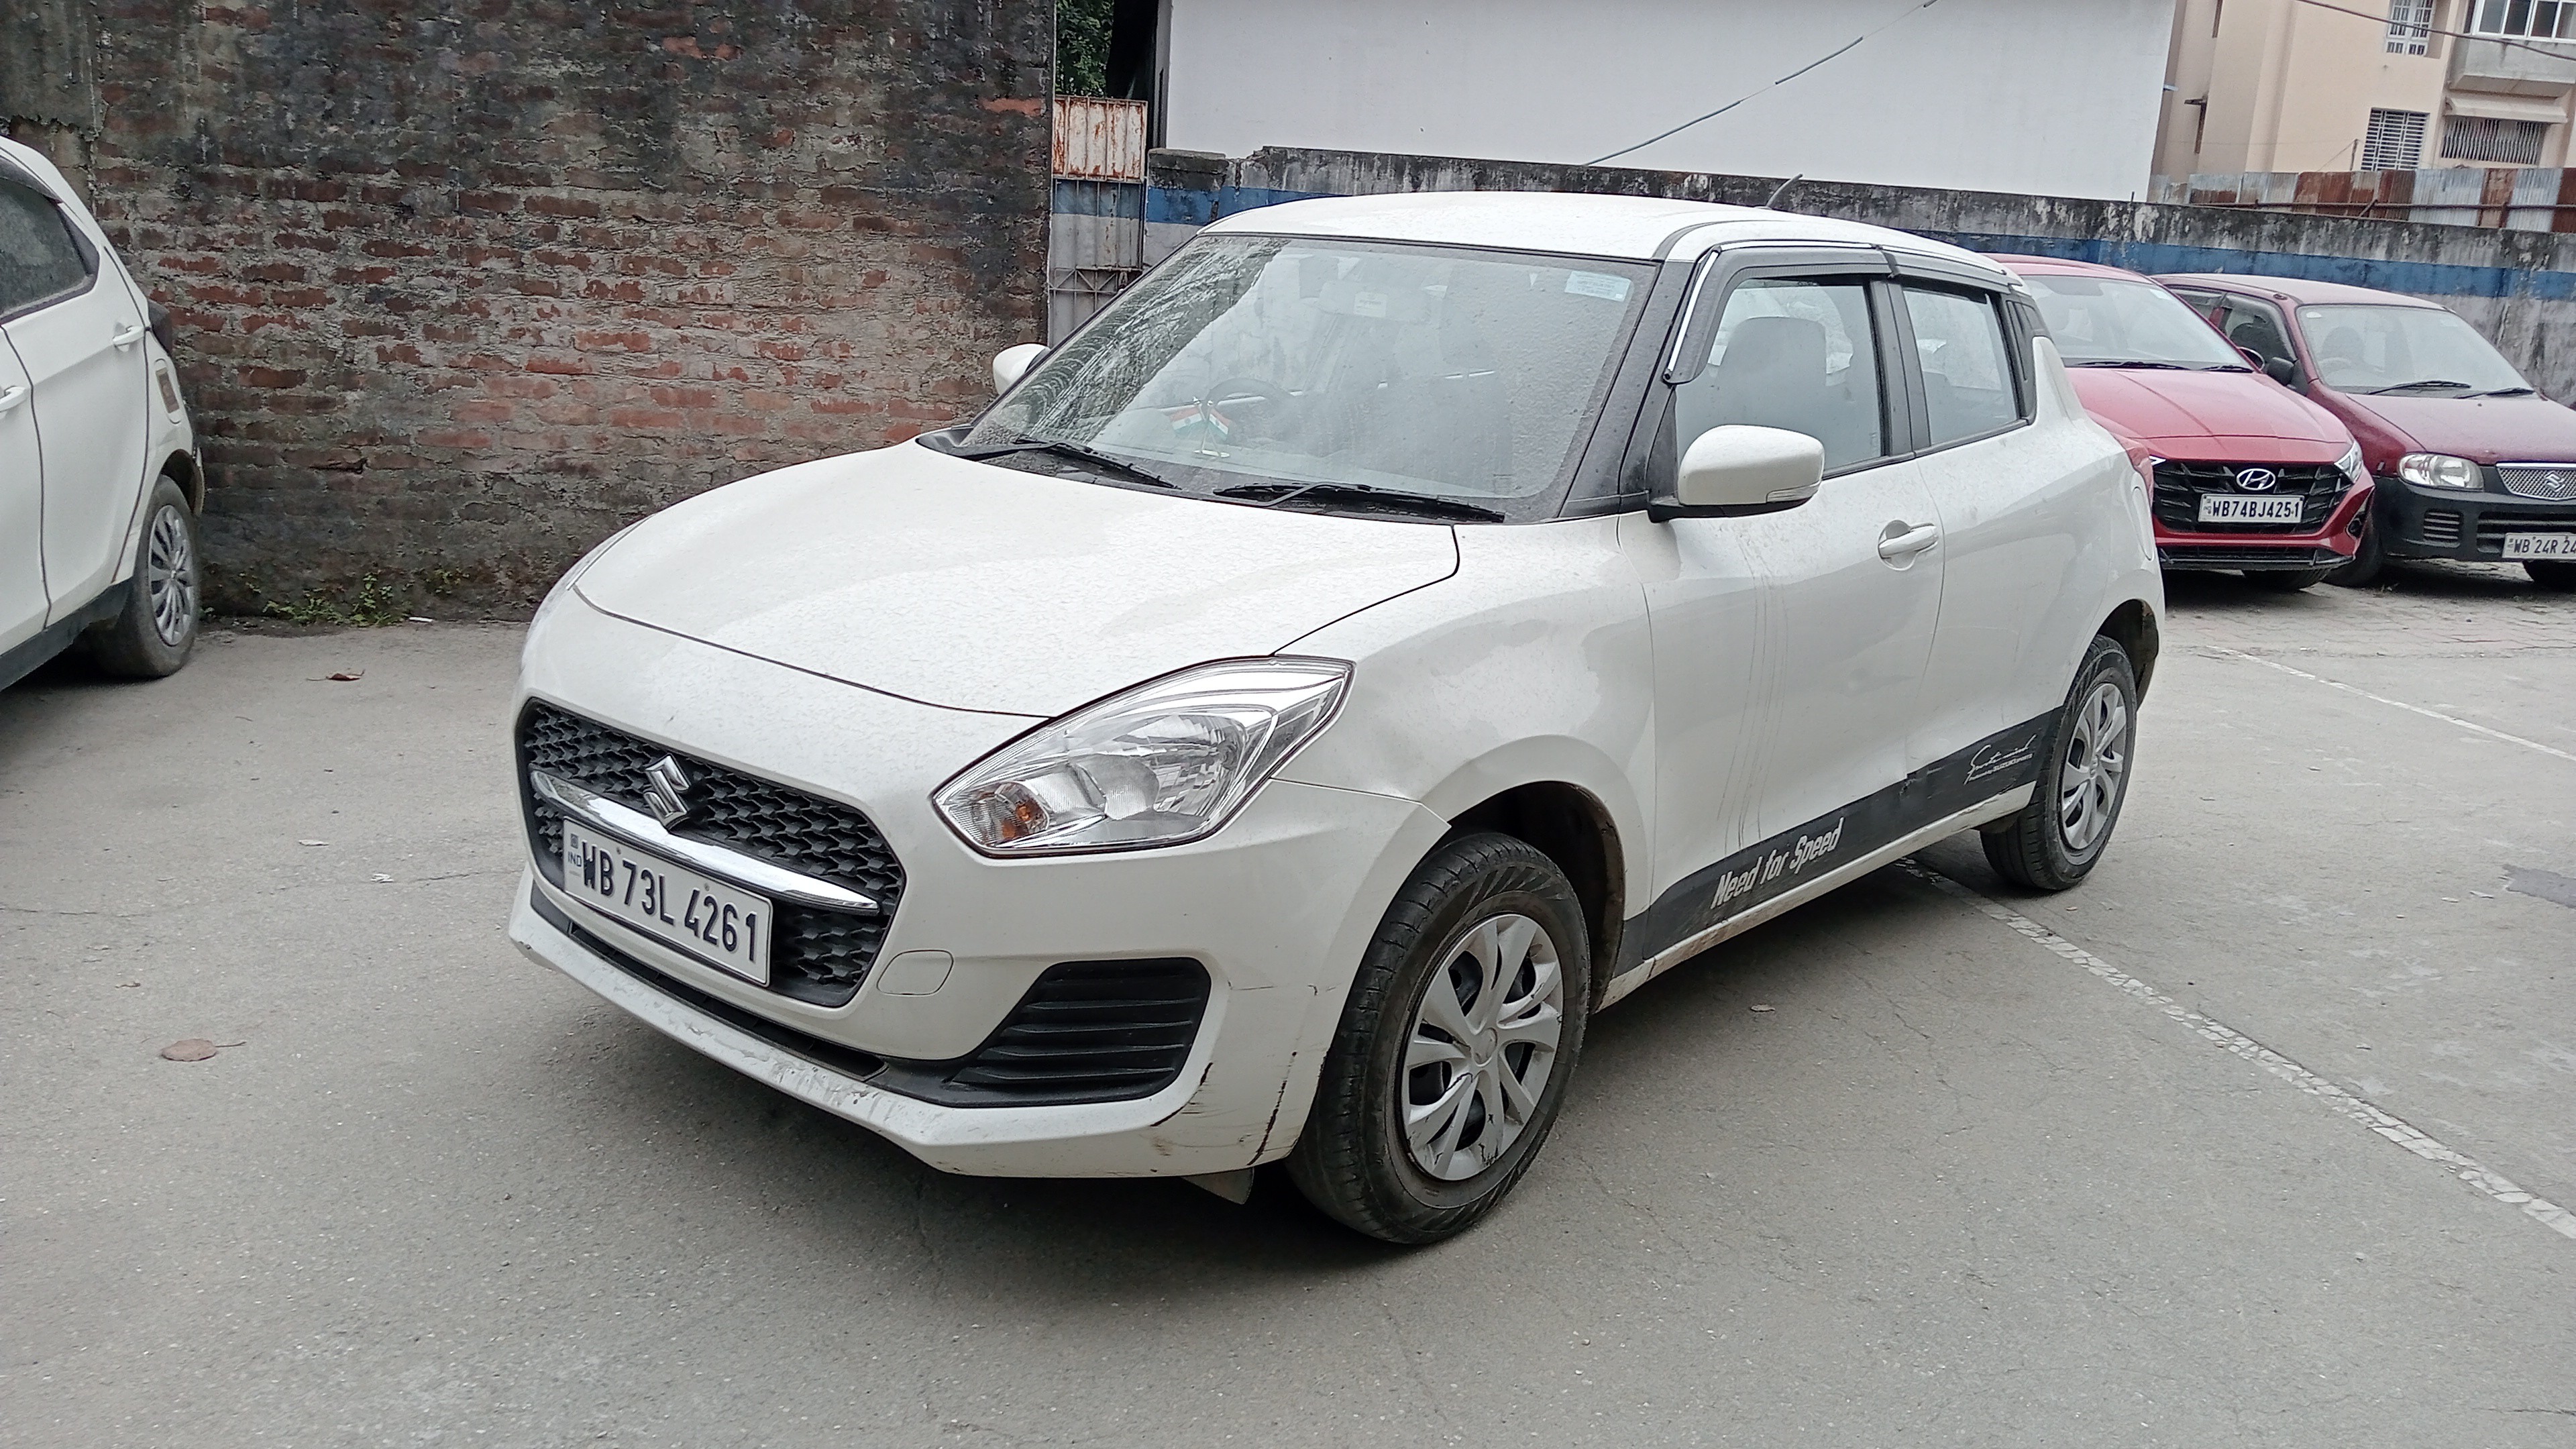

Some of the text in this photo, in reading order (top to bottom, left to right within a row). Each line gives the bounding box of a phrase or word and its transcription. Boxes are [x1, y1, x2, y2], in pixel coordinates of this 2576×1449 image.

[2212, 500, 2300, 517] WB74BJ4251
[2514, 539, 2530, 553] WB
[2534, 539, 2558, 553] 24R
[568, 851, 582, 867] IND
[1711, 816, 1844, 910] Need for Speed
[582, 840, 757, 961] WB 73L 4261
